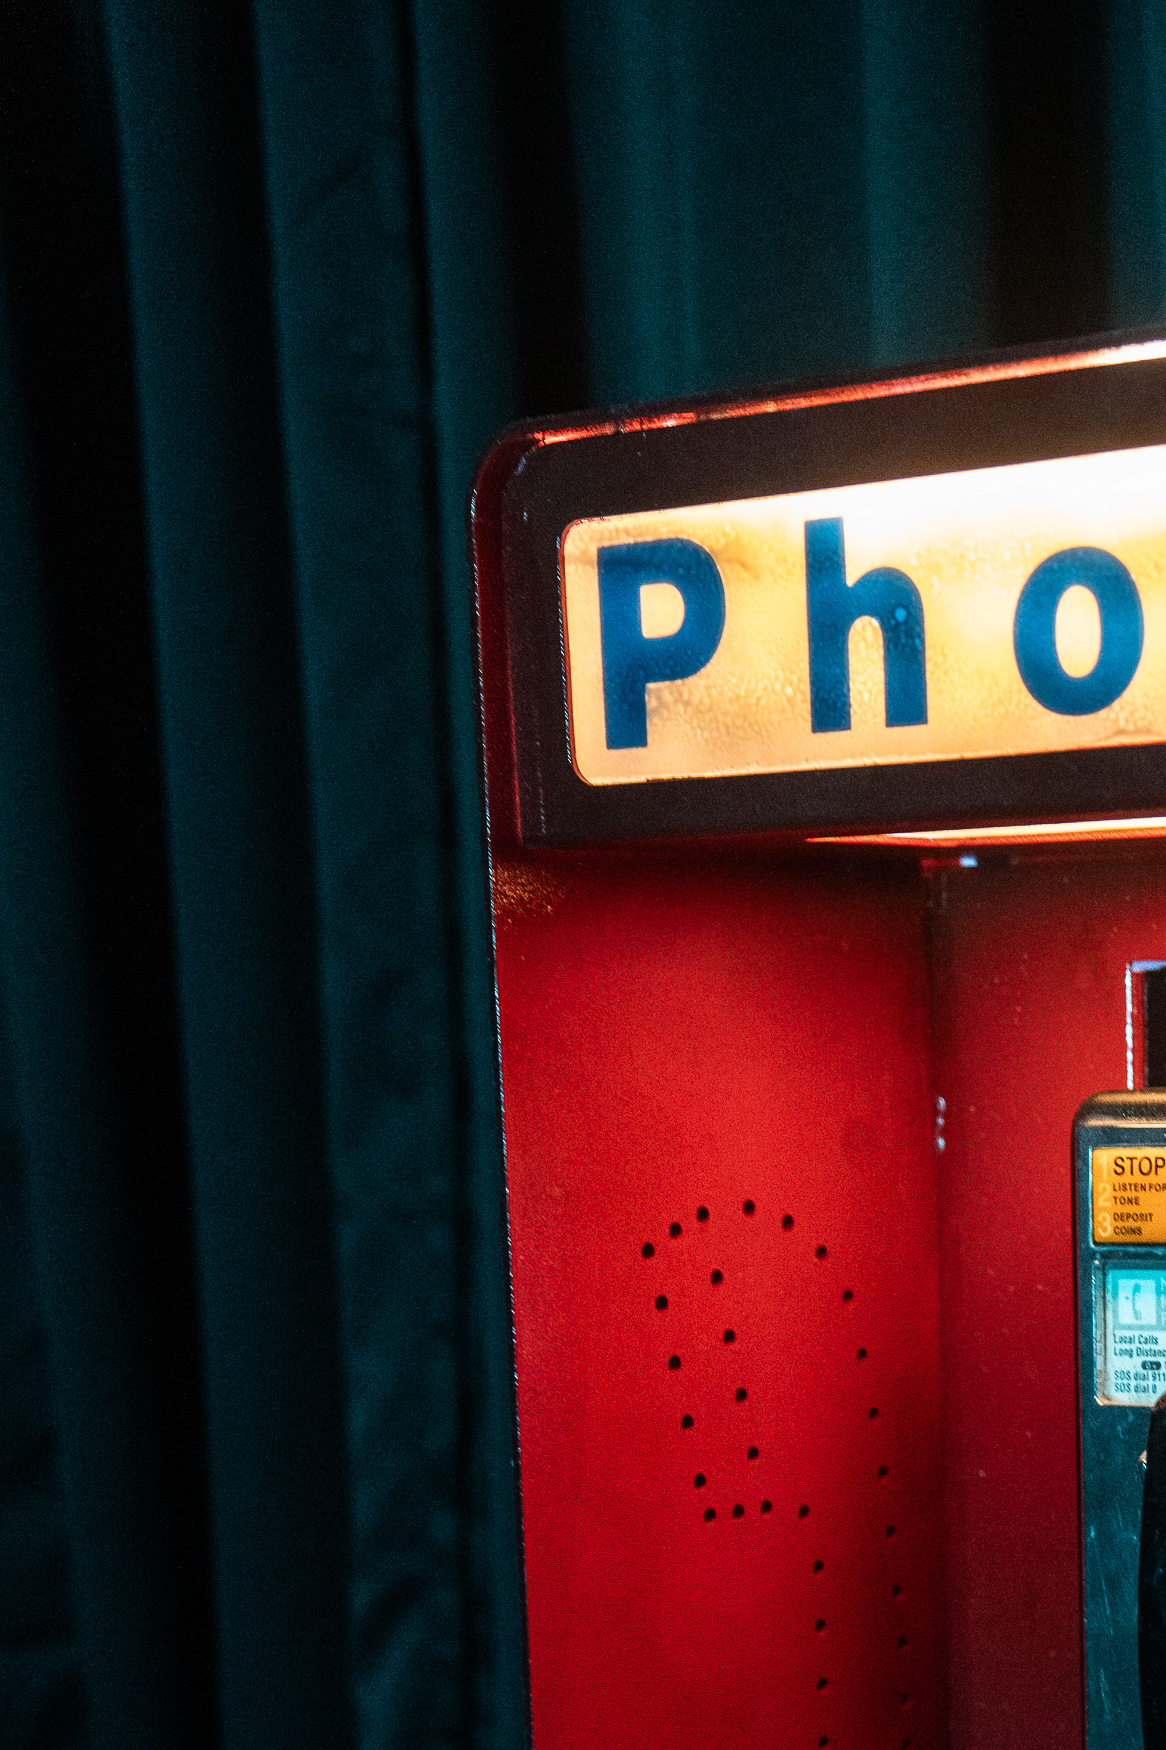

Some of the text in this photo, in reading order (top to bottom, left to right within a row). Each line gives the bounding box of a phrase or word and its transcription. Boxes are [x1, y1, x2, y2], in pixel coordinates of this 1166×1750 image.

[1113, 1156, 1166, 1176] STOP
[1112, 1182, 1147, 1192] LISTEN
[1112, 1196, 1140, 1205] TONE
[1098, 1212, 1153, 1237] 3 DEPOSIT
[1113, 1226, 1142, 1236] COINS
[1113, 1333, 1158, 1346] Local Calls
[1113, 1345, 1134, 1358] Long
[1114, 1370, 1166, 1382] SOS dial 911
[1114, 1383, 1131, 1393] SOS
[1134, 1383, 1149, 1394] dial
